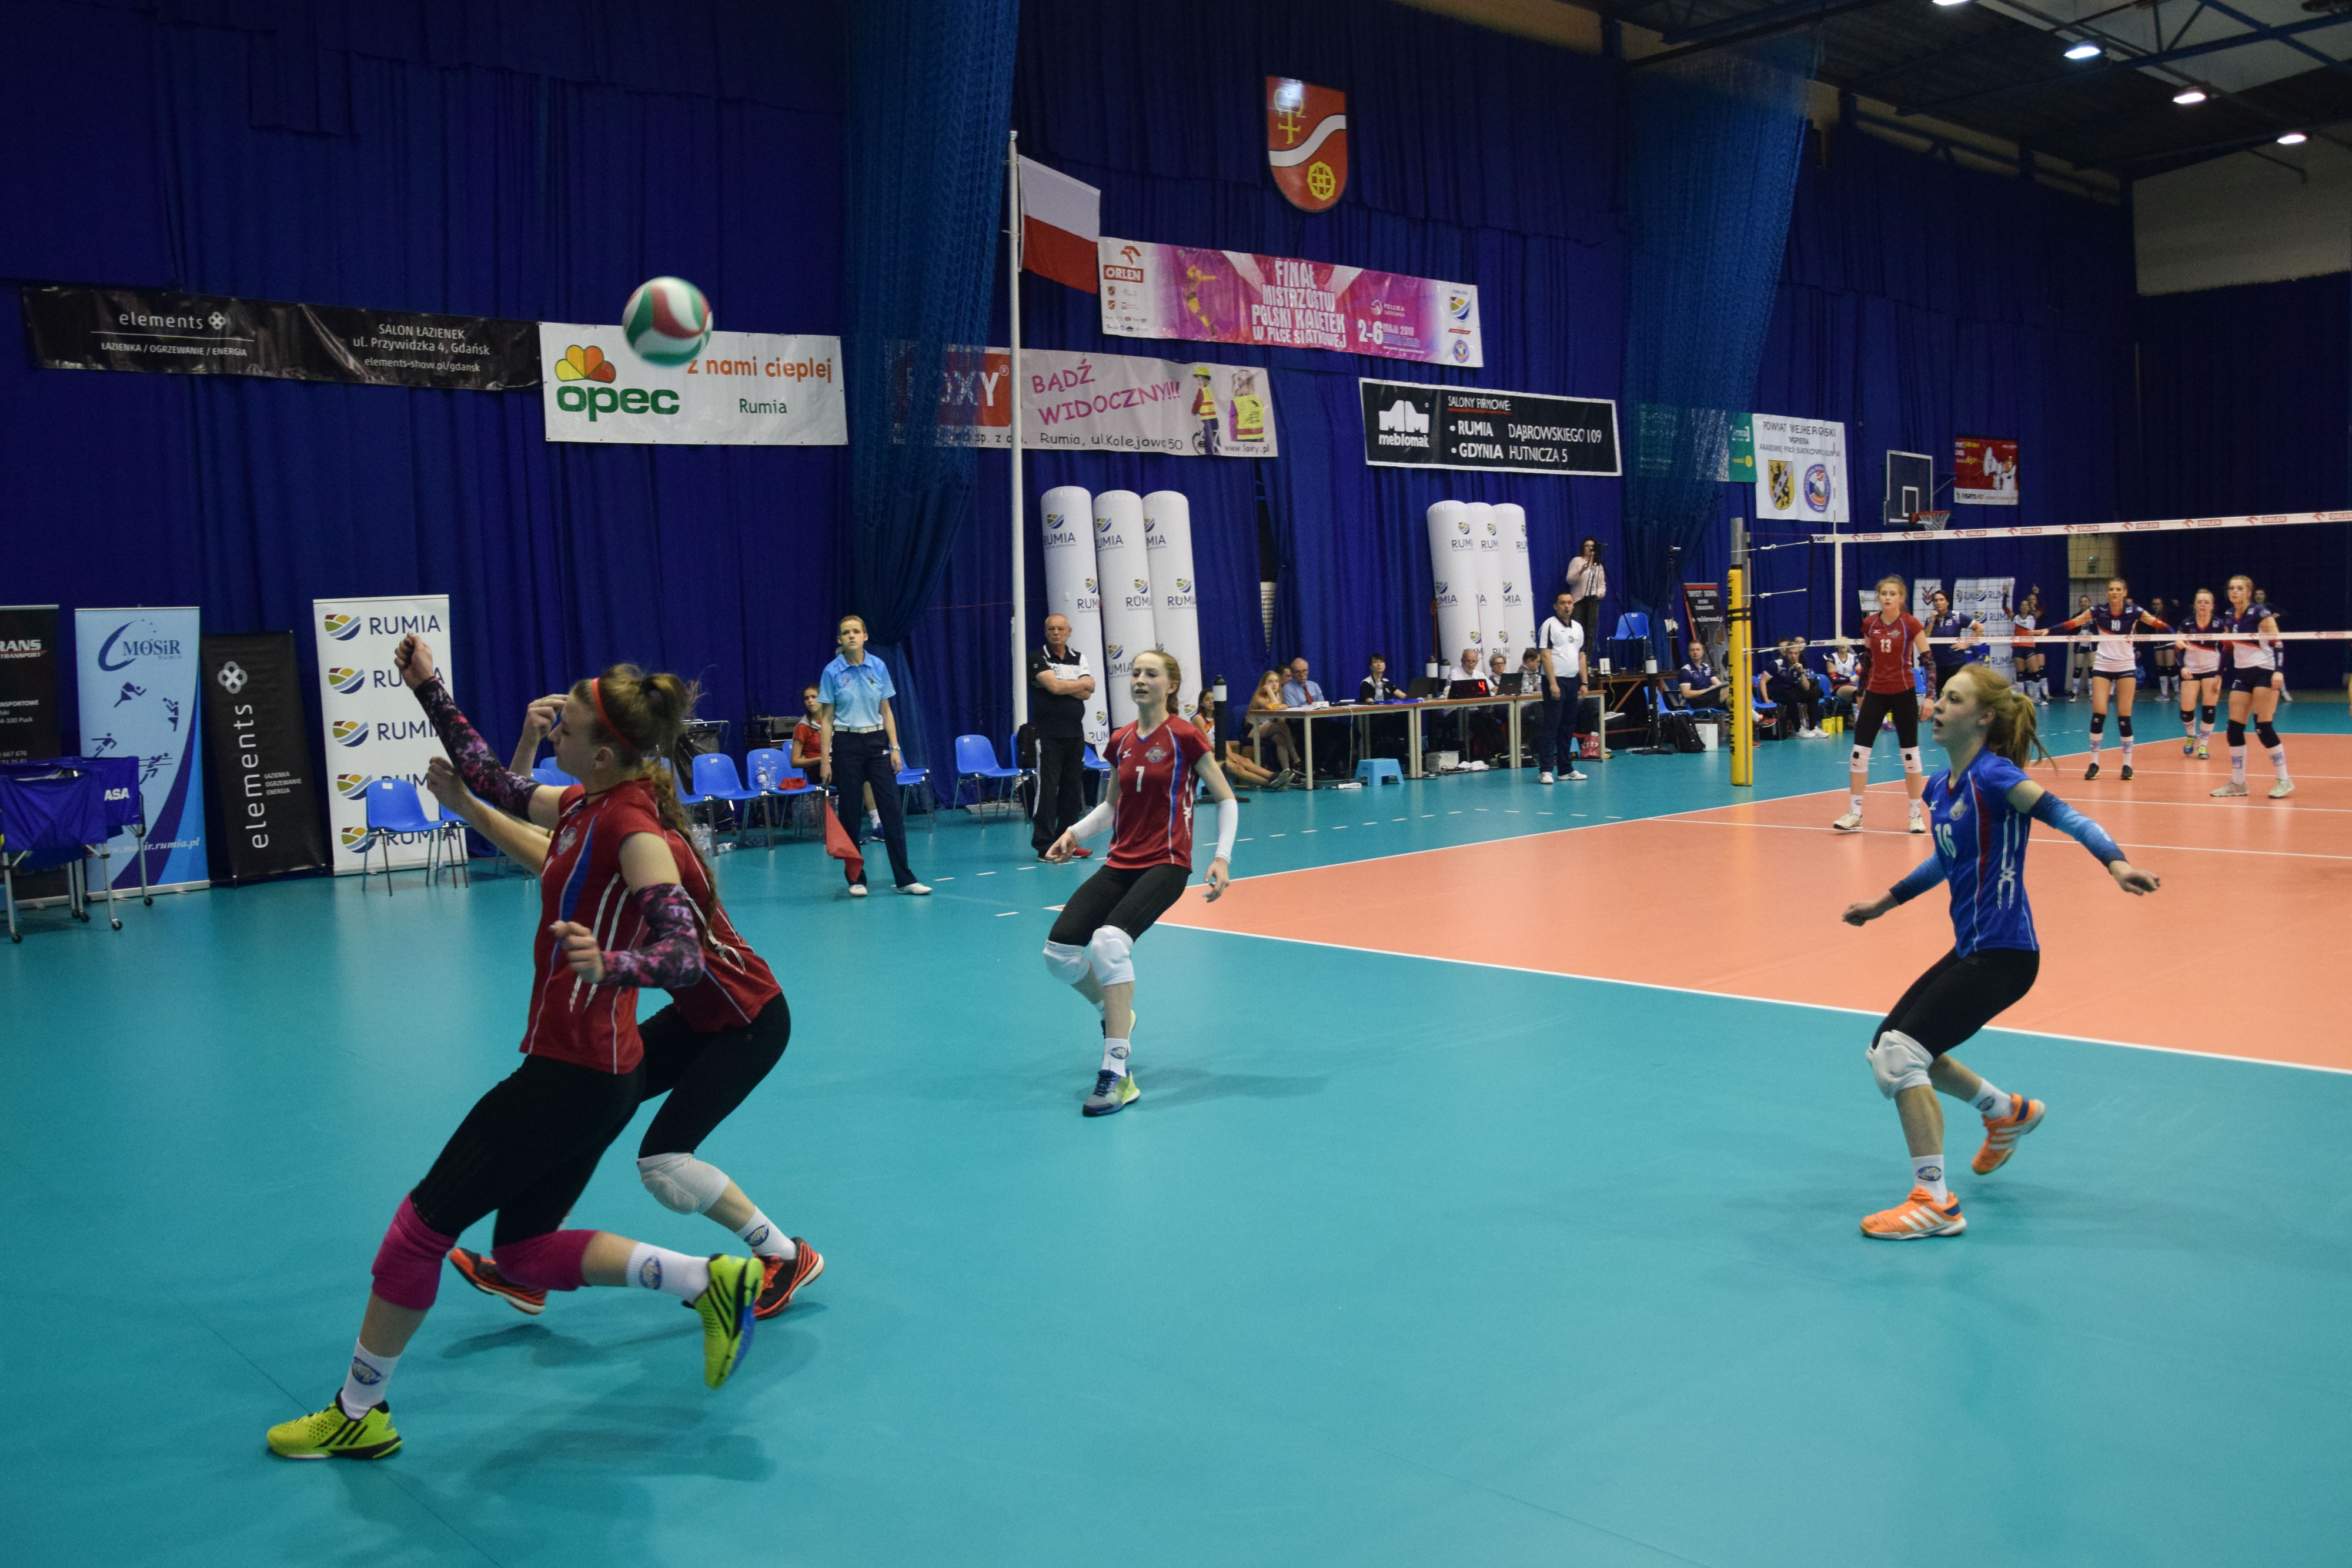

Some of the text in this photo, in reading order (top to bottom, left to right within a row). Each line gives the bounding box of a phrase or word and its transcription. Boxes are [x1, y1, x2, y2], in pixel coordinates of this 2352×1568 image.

[1105, 266, 1141, 282] ORLEN
[119, 311, 203, 329] elements
[1251, 303, 1292, 329] POLSKI
[378, 324, 466, 339] SALON ŁAZIENEK
[1252, 326, 1264, 340] W
[101, 342, 142, 352] ŁAZIENKA
[149, 345, 204, 355] OGRZEWANIE
[212, 347, 248, 356] ENERGIA
[353, 336, 490, 355] ul. Przywidzka 4, Gdańsk
[364, 357, 481, 372] elements-show.pl/gdansk
[706, 356, 758, 377] nami
[765, 357, 832, 383] cieplej
[1031, 358, 1095, 394] BĄDŹ
[556, 385, 680, 422] opec
[739, 398, 788, 414] Rumia
[1447, 396, 1475, 409] SALONY
[1458, 420, 1494, 437] RUMIA
[1508, 423, 1585, 443] DĄBROWSKIEGO
[1763, 421, 1787, 432] POWIAT
[1040, 432, 1085, 446] Rumia,
[1378, 433, 1429, 448] meblomak
[1459, 443, 1568, 463] GDYNIA HUTNICZA 5
[1094, 534, 1124, 549] UMIA
[369, 614, 441, 636] RUMIA
[1880, 638, 1892, 653] 13
[373, 667, 445, 688] RUA
[1477, 680, 1486, 692] 4
[377, 720, 440, 741] RUMI
[233, 704, 269, 849] elements
[1135, 766, 1145, 793] 7
[1935, 823, 1956, 859] 16
